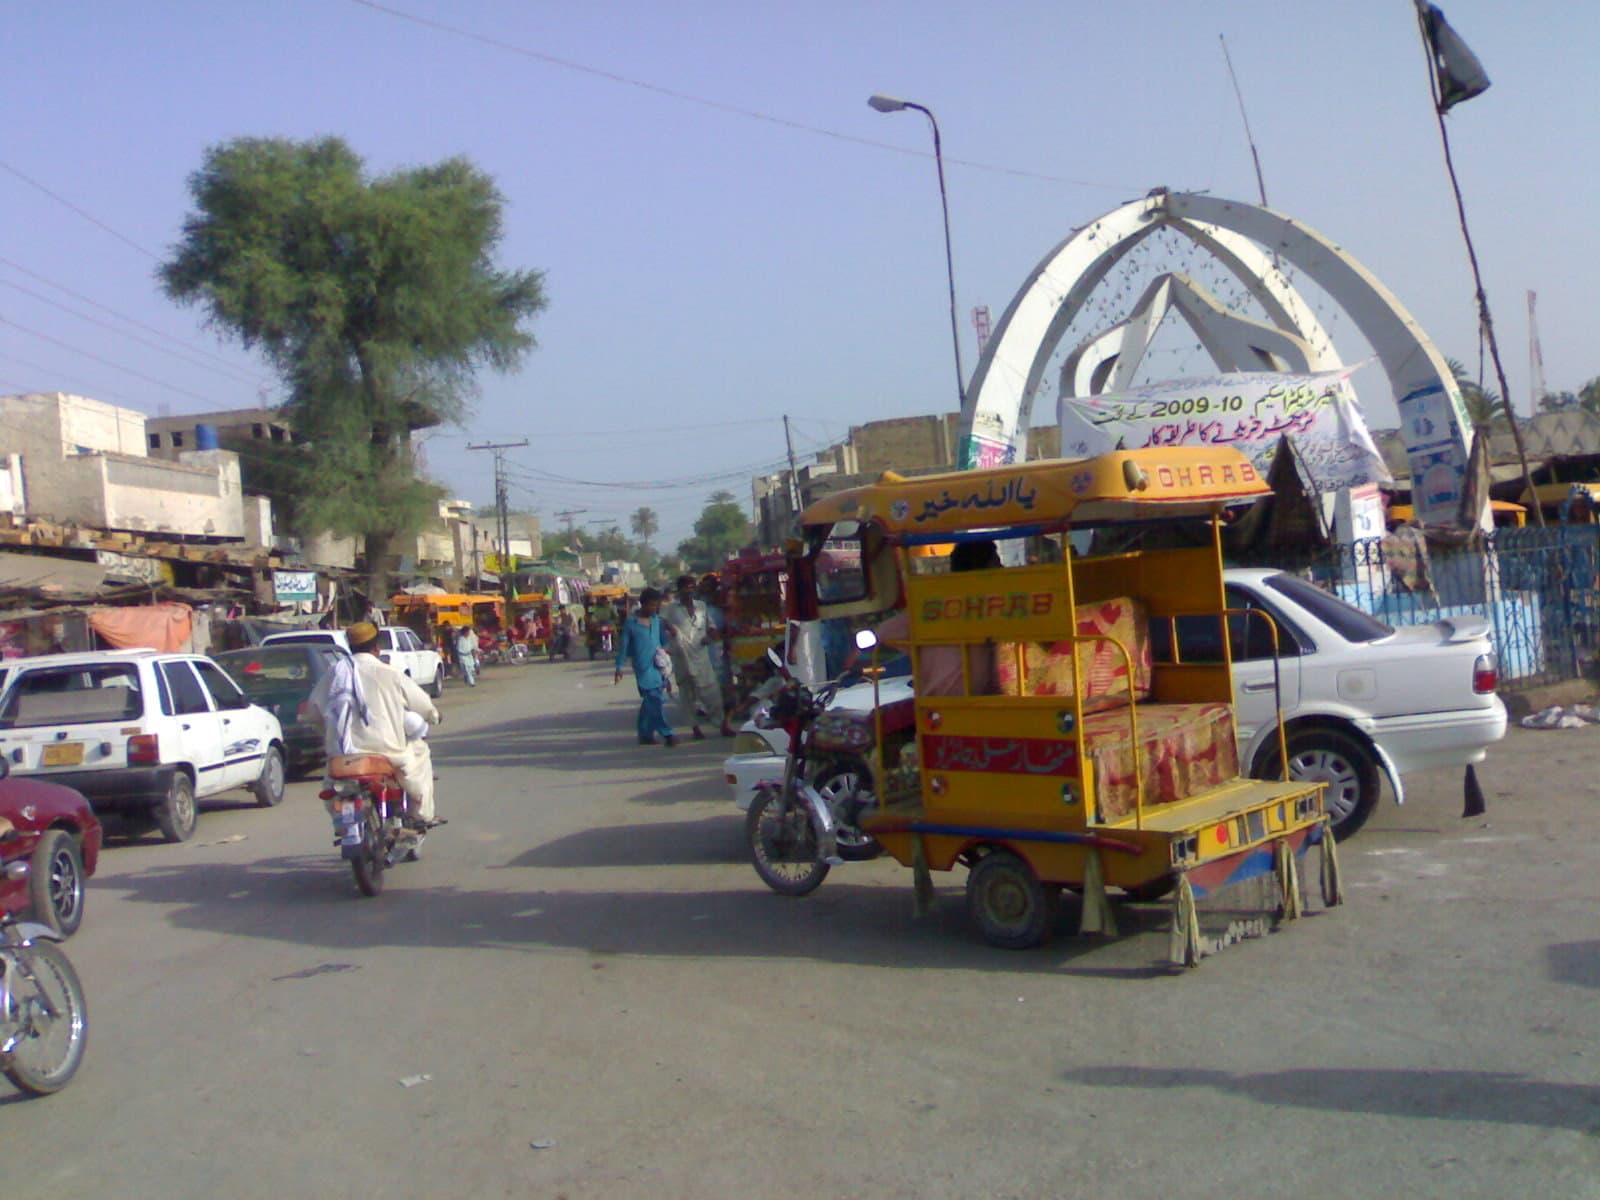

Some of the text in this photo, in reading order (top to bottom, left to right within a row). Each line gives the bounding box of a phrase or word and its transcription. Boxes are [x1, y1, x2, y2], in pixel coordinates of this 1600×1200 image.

[1150, 396, 1243, 417] 2009-10
[914, 490, 959, 522] خیر
[920, 592, 1055, 624] SOHRAB
